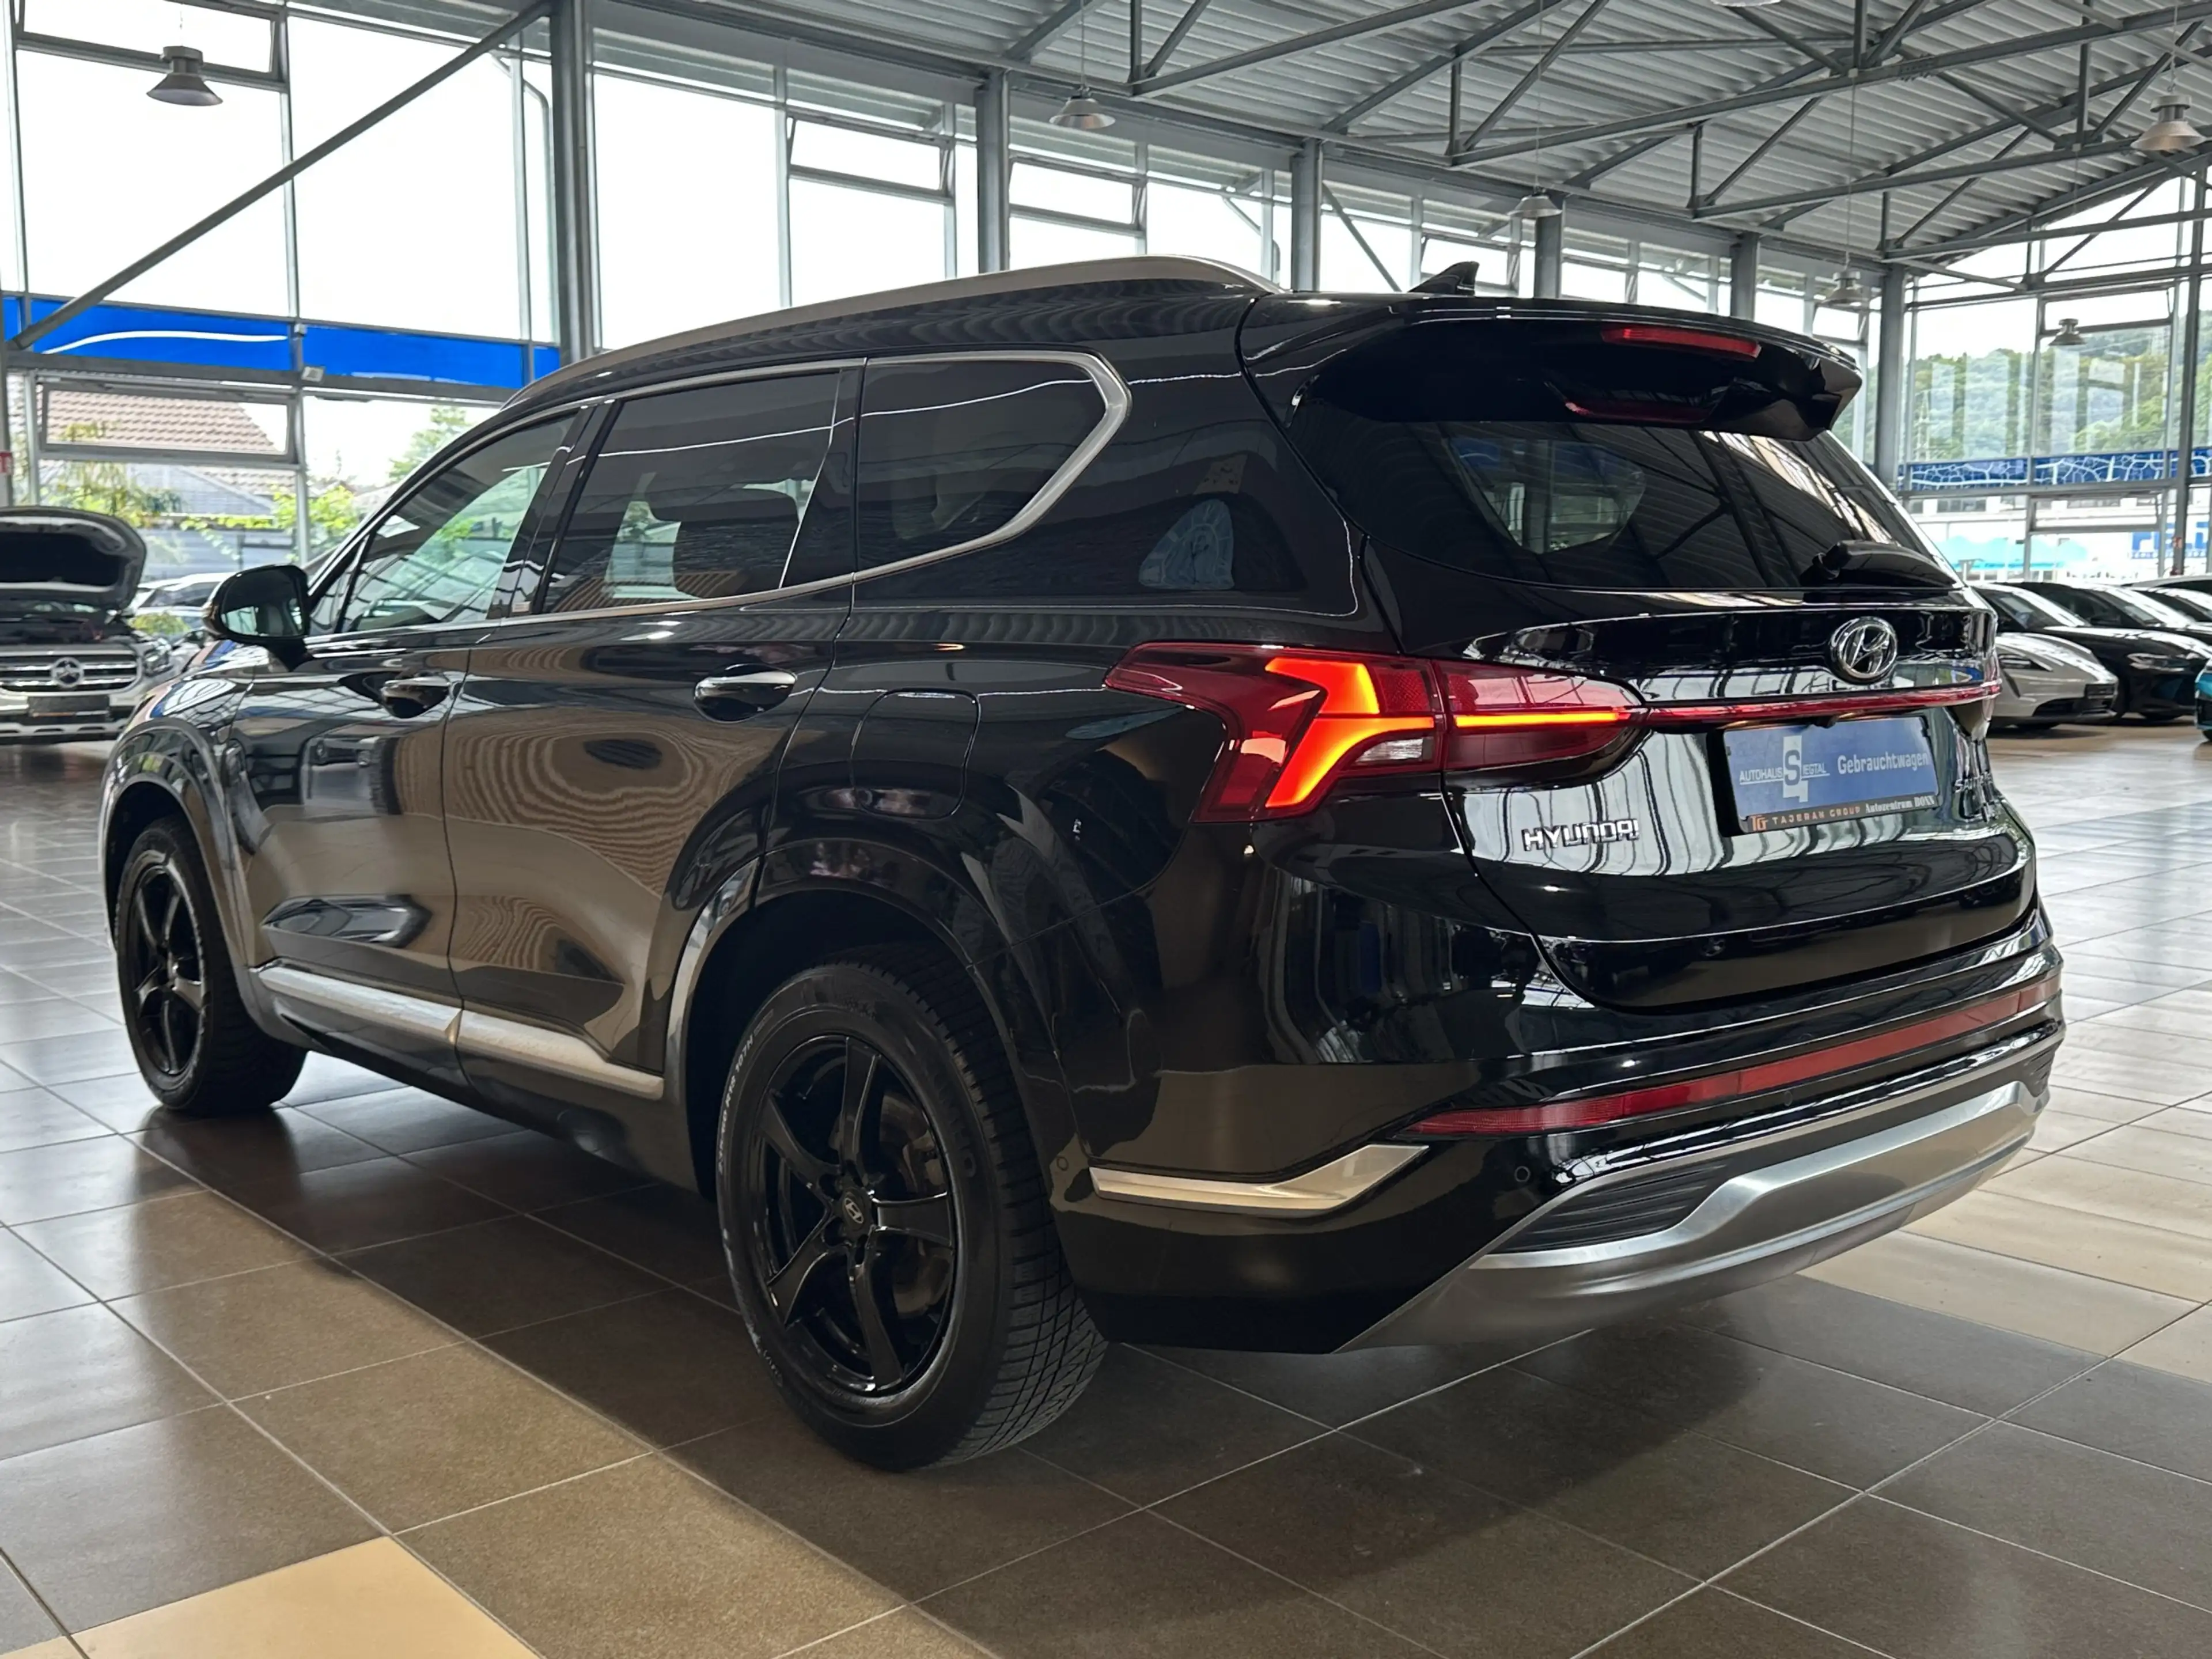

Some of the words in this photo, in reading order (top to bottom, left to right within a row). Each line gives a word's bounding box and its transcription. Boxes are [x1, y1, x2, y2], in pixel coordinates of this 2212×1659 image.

[1837, 751, 1929, 775] Gebrauchtwagen
[1739, 767, 1784, 782] AUTOHAUS
[1772, 811, 1825, 825] TAJERAN
[1829, 806, 1861, 818] GROUP
[1865, 800, 1912, 813] Autozentrum
[1521, 818, 1640, 852] HYUNDAI
